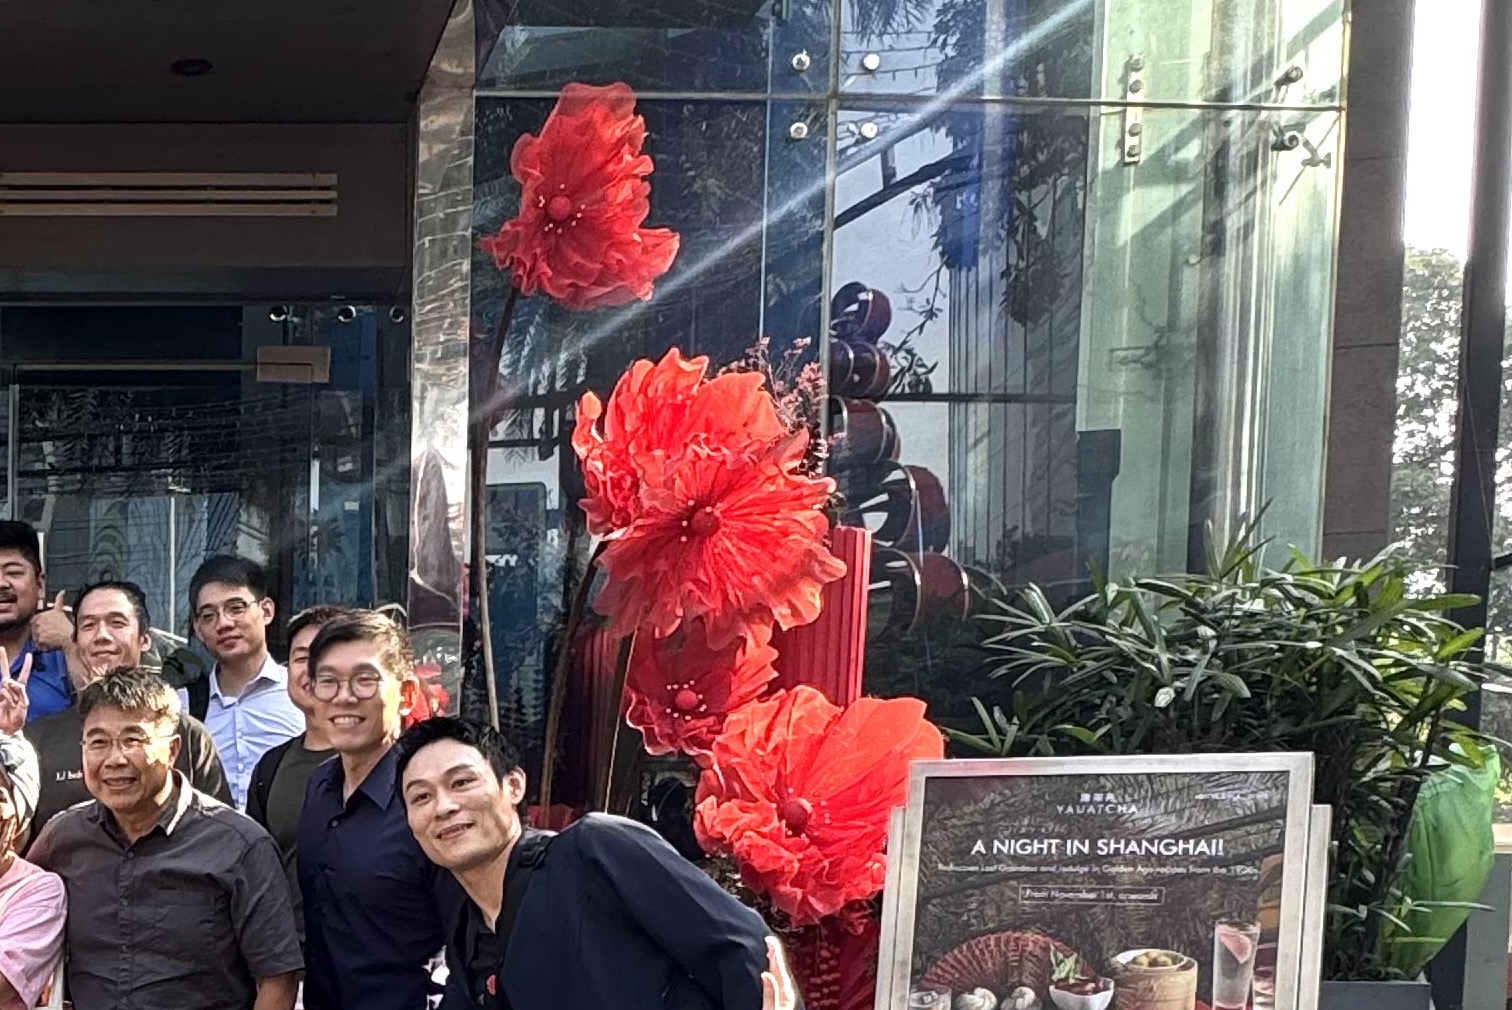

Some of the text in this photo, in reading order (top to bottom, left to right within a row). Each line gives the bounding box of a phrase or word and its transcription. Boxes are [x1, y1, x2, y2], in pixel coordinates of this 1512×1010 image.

[1056, 804, 1139, 815] YAUATCHA
[971, 838, 1224, 857] A NIGHT IN SHANGHAI!
